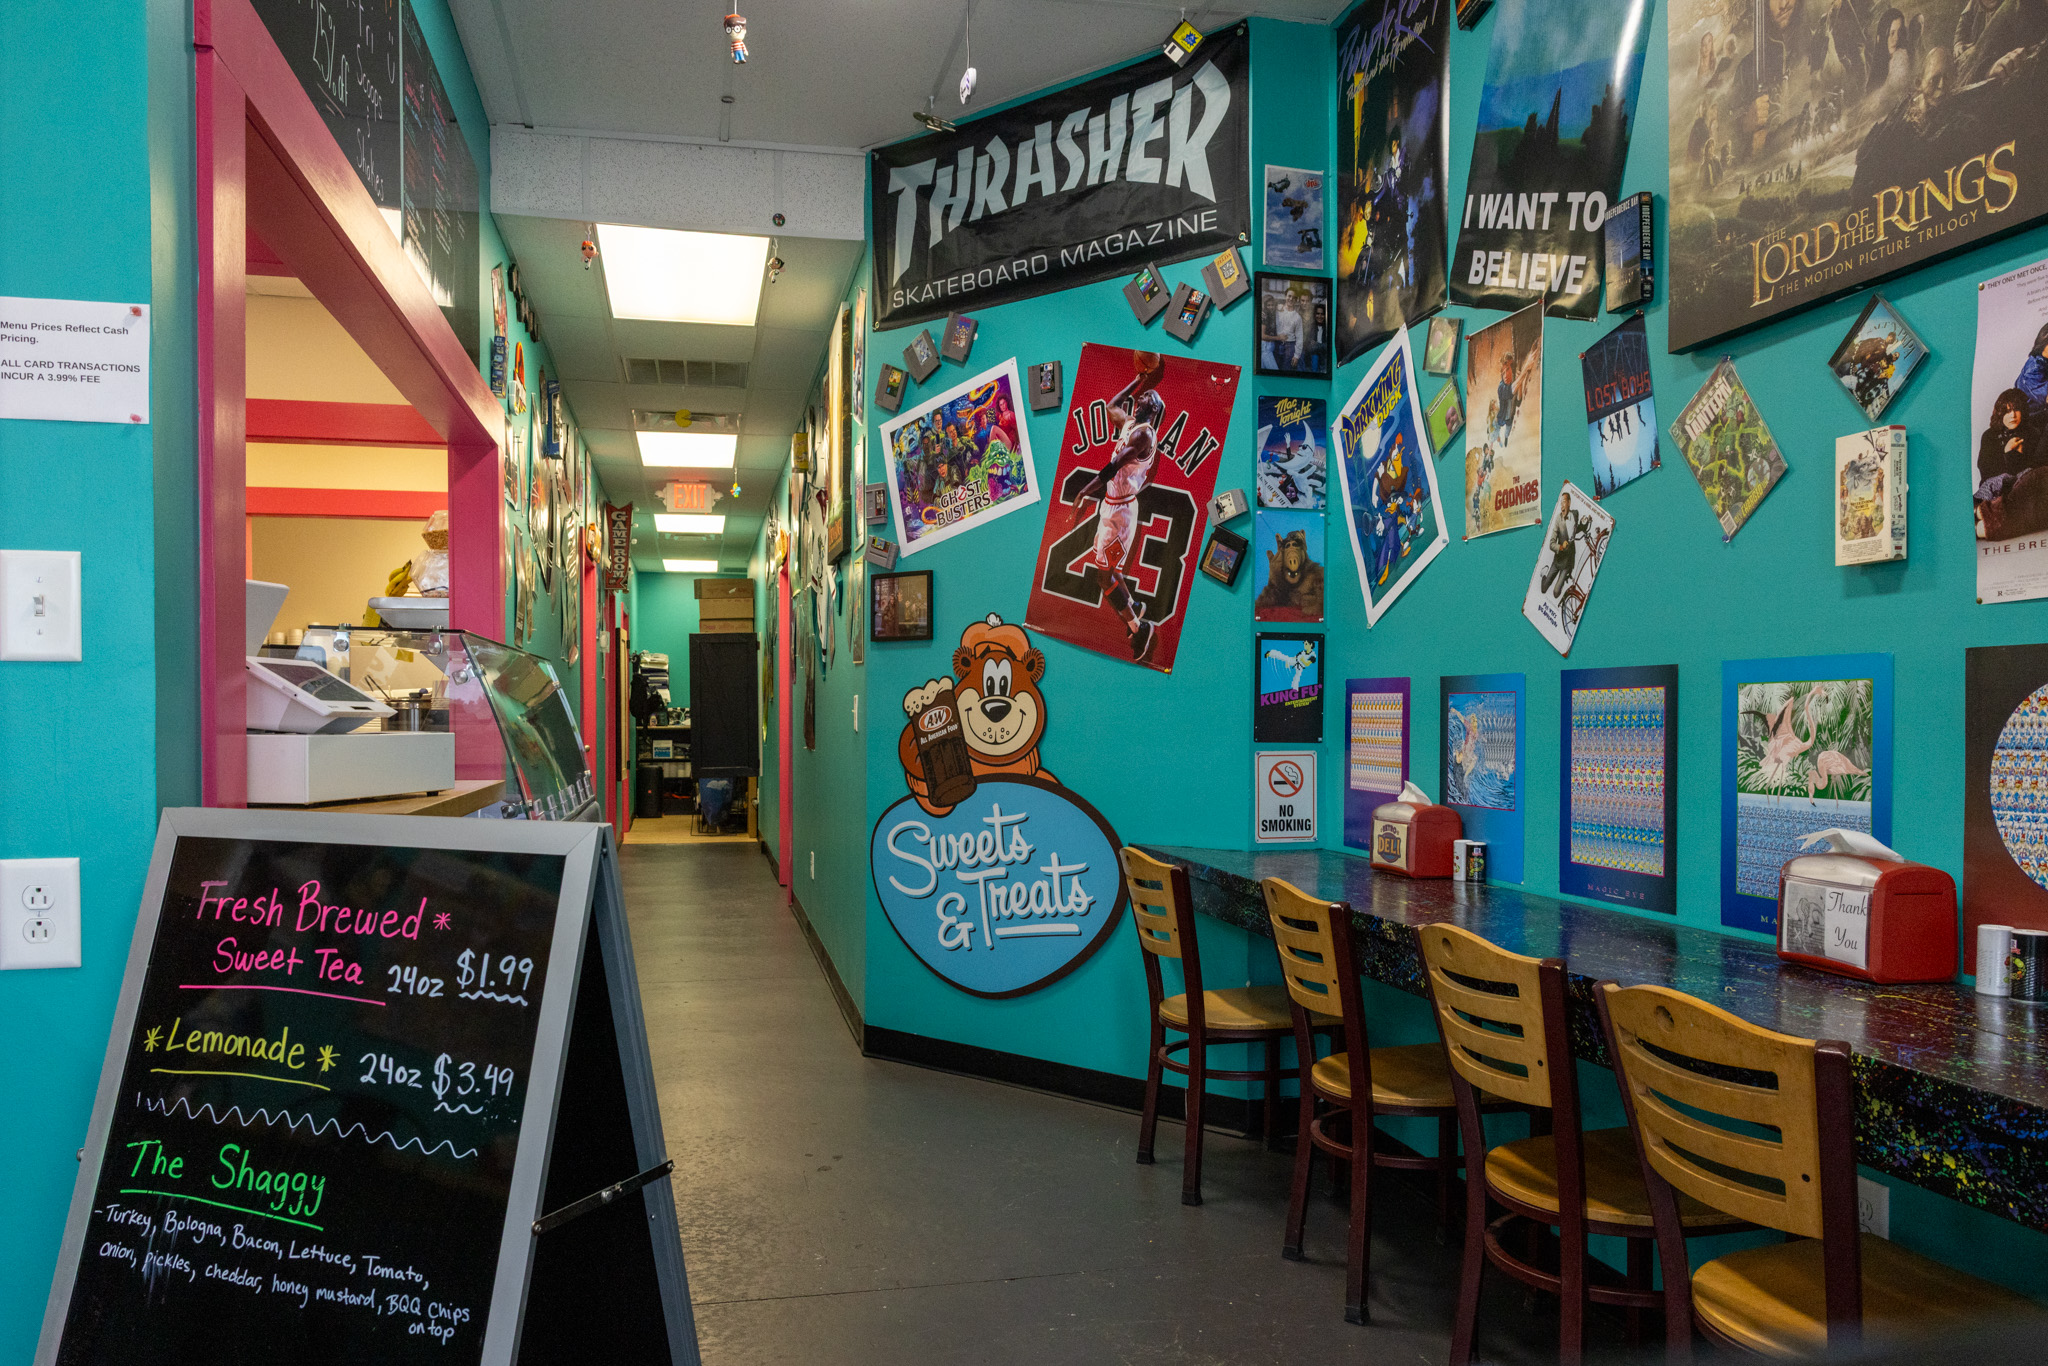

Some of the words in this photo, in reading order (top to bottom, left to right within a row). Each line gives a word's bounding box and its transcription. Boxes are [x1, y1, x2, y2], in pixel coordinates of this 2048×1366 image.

[337, 53, 350, 107] off
[356, 43, 383, 121] Scoops
[356, 127, 385, 201] Shakes
[888, 59, 1231, 287] THRASHER
[1872, 140, 2018, 244] RINGS
[1464, 194, 1474, 229] I
[1479, 192, 1559, 231] WANT
[1566, 191, 1607, 232] TO
[1641, 205, 1651, 248] INDEPENDENCE
[1845, 208, 1869, 231] OF
[1642, 248, 1651, 260] DAY
[1764, 228, 1787, 245] THE
[1779, 281, 1799, 296] THE
[1804, 259, 1853, 288] MOTION
[1859, 236, 1911, 265] PICTURE
[1918, 209, 1978, 243] TRILOGY
[1840, 223, 1876, 251] THE
[892, 254, 1049, 309] SKATEBOARD
[1060, 209, 1218, 268] MAGAZINE
[1468, 250, 1587, 295] BELIEVE
[1750, 221, 1840, 307] LORD
[1987, 280, 2001, 289] THEY
[2002, 275, 2017, 284] ONLY
[2017, 270, 2029, 279] MET
[2030, 264, 2048, 274] ONCE,
[0, 321, 28, 330] Menu
[30, 322, 62, 332] Prices
[65, 324, 101, 334] Reflect
[103, 326, 129, 335] Cash
[0, 334, 39, 345] Pricing.
[1, 359, 21, 368] ALL
[24, 360, 55, 369] CARD
[57, 361, 140, 373] TRANSACTIONS
[1, 372, 34, 381] INCUR
[37, 373, 45, 381] A
[48, 374, 77, 383] 3.99%
[80, 375, 100, 384] FEE
[1274, 398, 1297, 414] Mac
[1341, 353, 1401, 458] DARKWING
[1377, 384, 1403, 428] DUCK
[1586, 381, 1618, 412] LOST
[1621, 371, 1651, 400] BOYS
[1684, 376, 1733, 442] LANTERN
[1686, 376, 1724, 426] GREEN
[1279, 401, 1312, 426] Tonight
[674, 484, 707, 509] EXIT
[1495, 479, 1539, 511] GOONIES
[1512, 475, 1520, 484] THE
[611, 511, 628, 546] GAME
[936, 492, 991, 527] BUSTERS
[612, 549, 627, 578] ROOM
[1041, 466, 1198, 626] 23
[1982, 544, 2011, 555] THE
[1261, 689, 1298, 706] KUNG
[1261, 818, 1312, 833] SMOKING
[1279, 804, 1294, 818] NO
[887, 802, 1034, 896] Sweets
[1378, 836, 1400, 855] DELI
[196, 880, 283, 924] Fresh
[295, 879, 428, 940] Brewed
[936, 891, 974, 950] &
[956, 852, 1094, 949] Treats
[1587, 883, 1619, 895] MAGIC
[1625, 890, 1645, 900] EYE
[1827, 891, 1867, 917] Thank
[1834, 926, 1858, 950] You
[212, 937, 304, 975] Sweet
[314, 947, 365, 986] Tea
[386, 964, 444, 998] 24oz
[456, 948, 534, 994] $1.99
[165, 1016, 306, 1069] Lemonade
[359, 1053, 423, 1089] 24oz
[432, 1052, 514, 1099] $3.49
[126, 1140, 184, 1179] The
[211, 1144, 327, 1216] Shaggy
[163, 1210, 228, 1247] Bologna,
[232, 1223, 284, 1261] Bacon,
[288, 1239, 357, 1274] Lettuce,
[361, 1254, 430, 1291] Tomato,
[99, 1241, 137, 1273] onion,
[143, 1249, 197, 1282] pickles,
[205, 1263, 263, 1296] cheddar,
[271, 1277, 309, 1308] honey
[316, 1286, 383, 1316] mustard,
